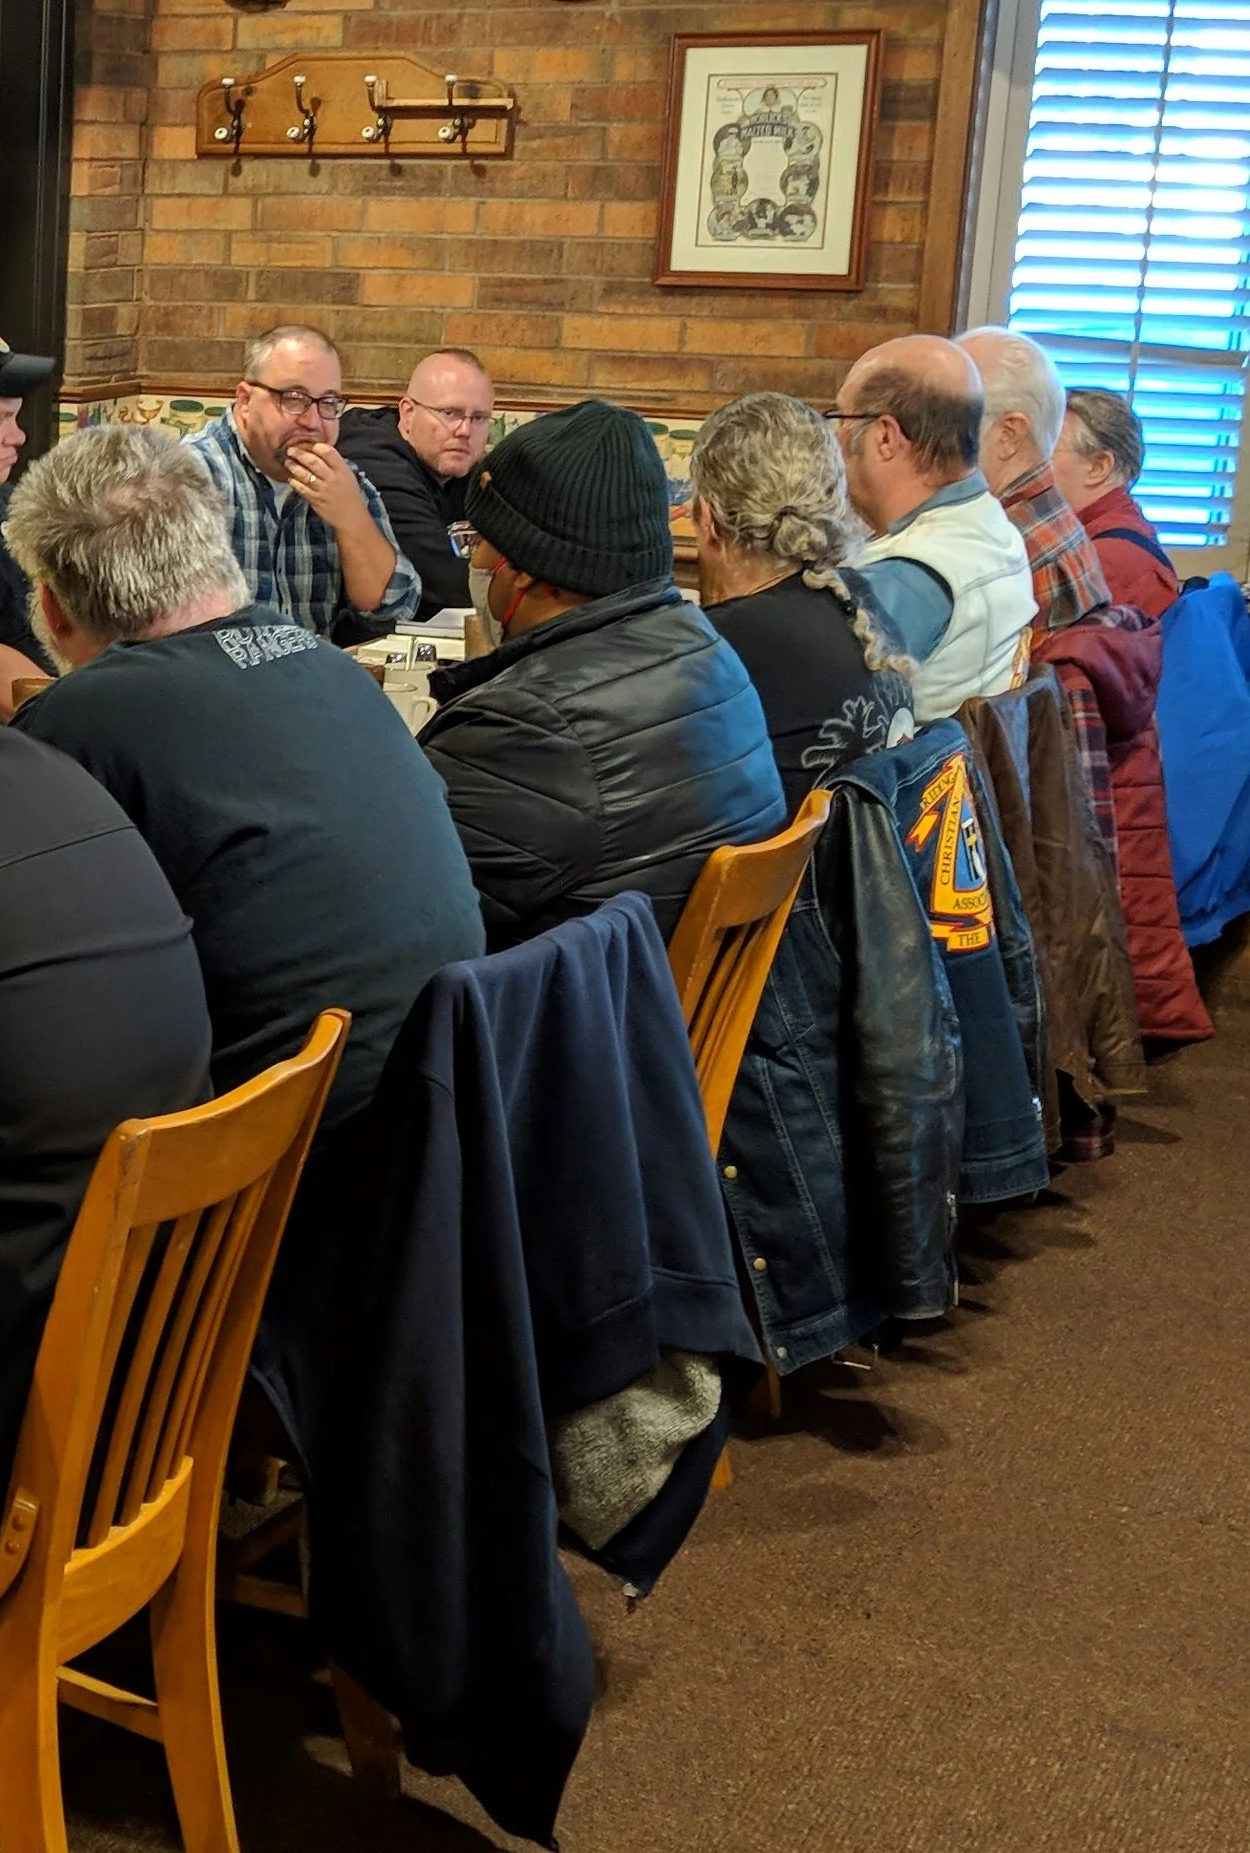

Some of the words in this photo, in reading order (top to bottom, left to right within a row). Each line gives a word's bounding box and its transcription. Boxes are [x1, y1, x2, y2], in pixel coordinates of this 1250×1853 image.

[920, 772, 957, 809] RIDING
[939, 796, 961, 886] CHRISTIAN
[957, 932, 983, 947] THE
